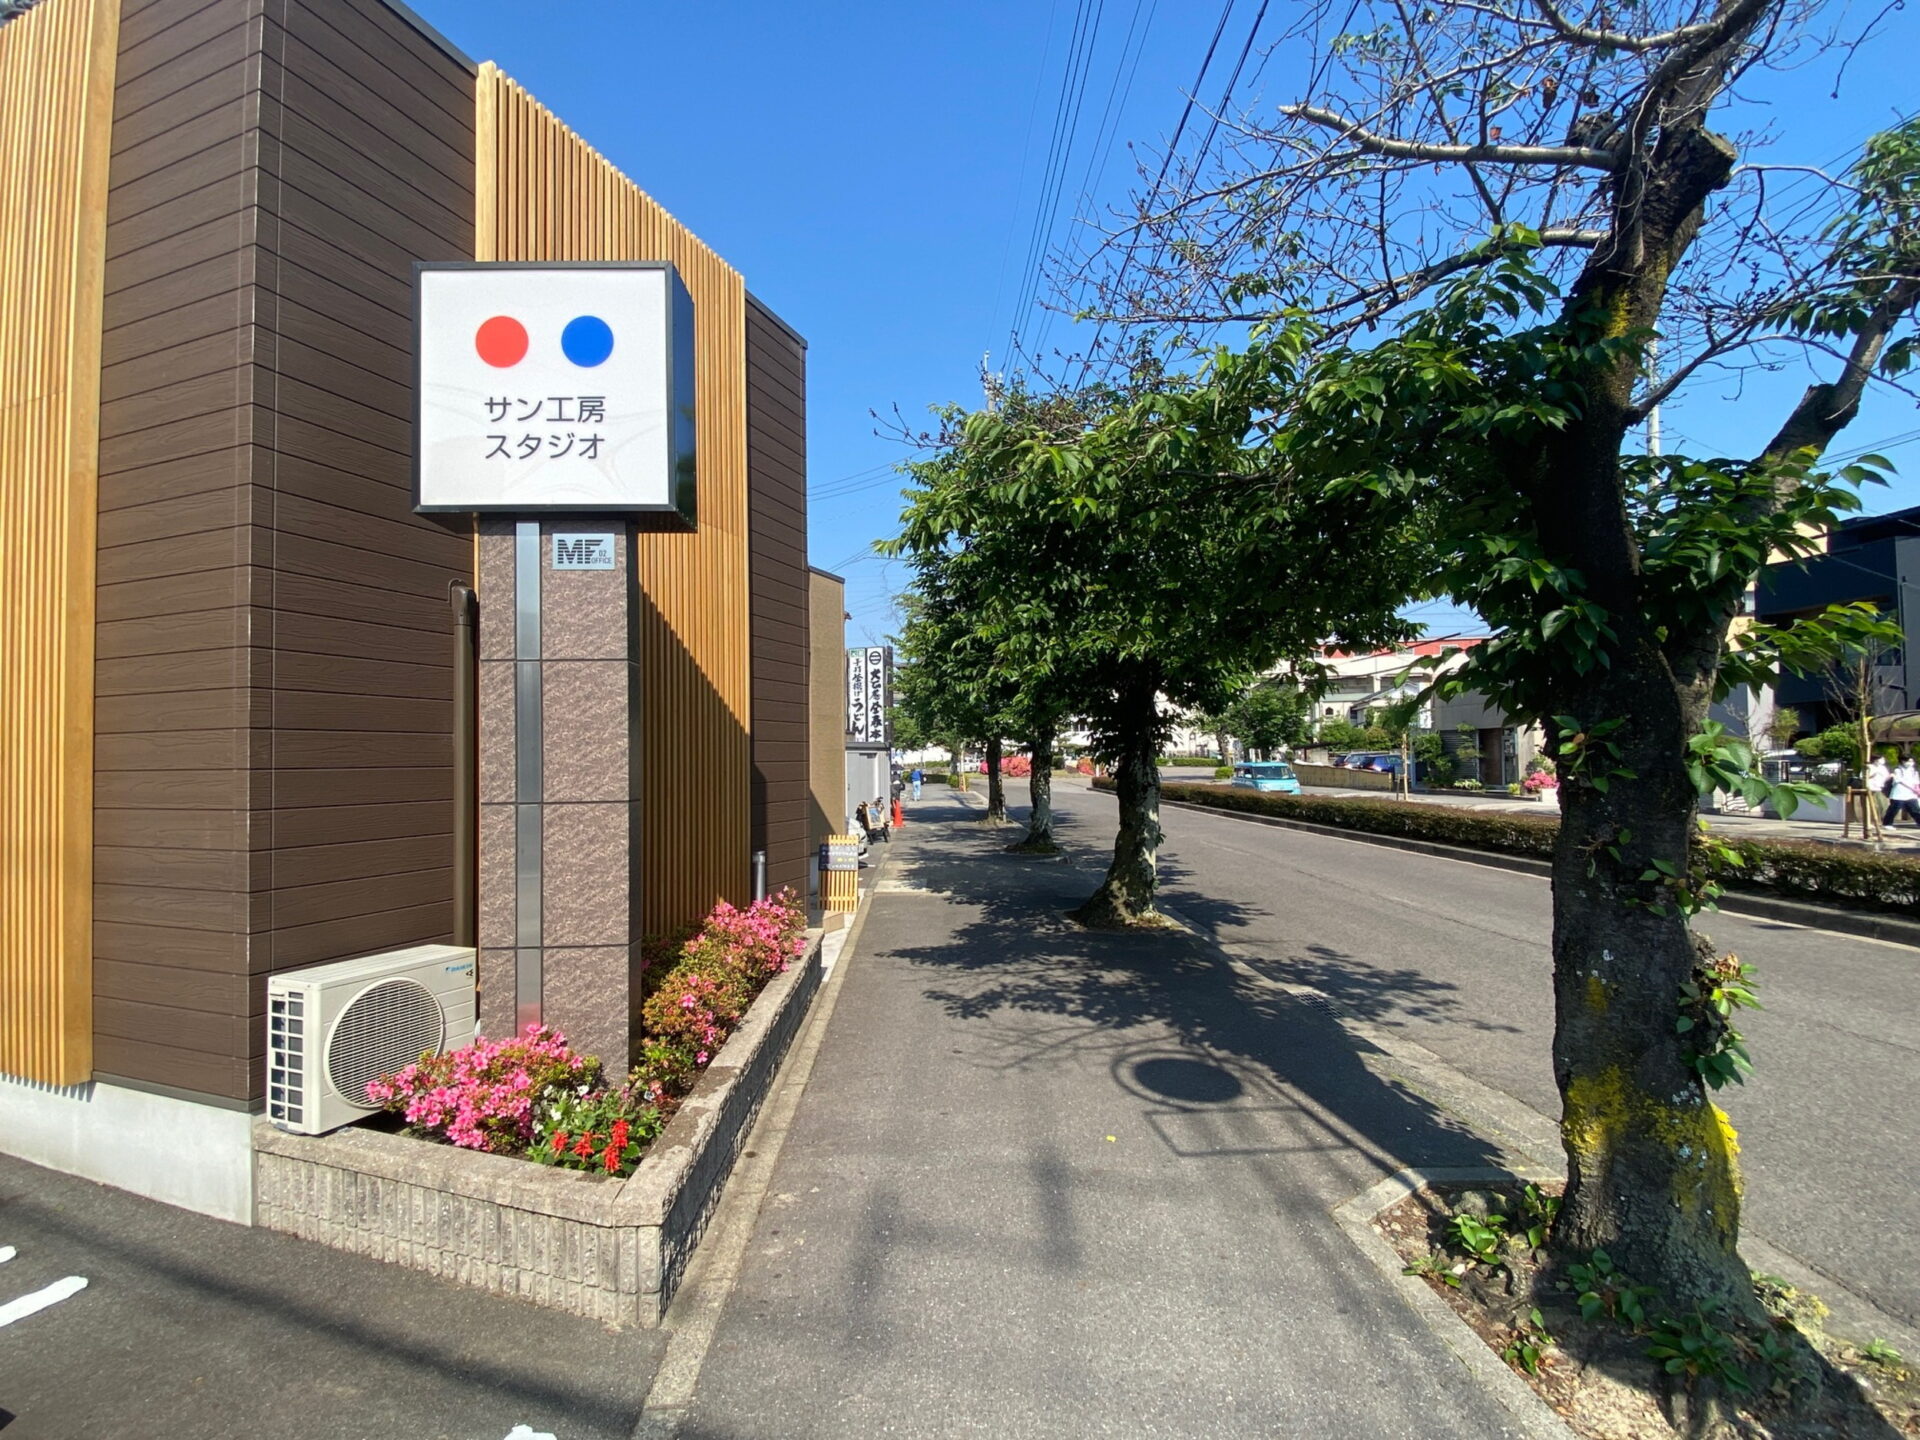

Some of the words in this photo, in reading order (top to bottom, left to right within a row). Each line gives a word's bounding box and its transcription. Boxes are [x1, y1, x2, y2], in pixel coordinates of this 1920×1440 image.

[484, 396, 606, 423] サン工房
[485, 433, 605, 460] スタジオ
[557, 539, 604, 564] MF
[590, 556, 612, 564] OFFICE
